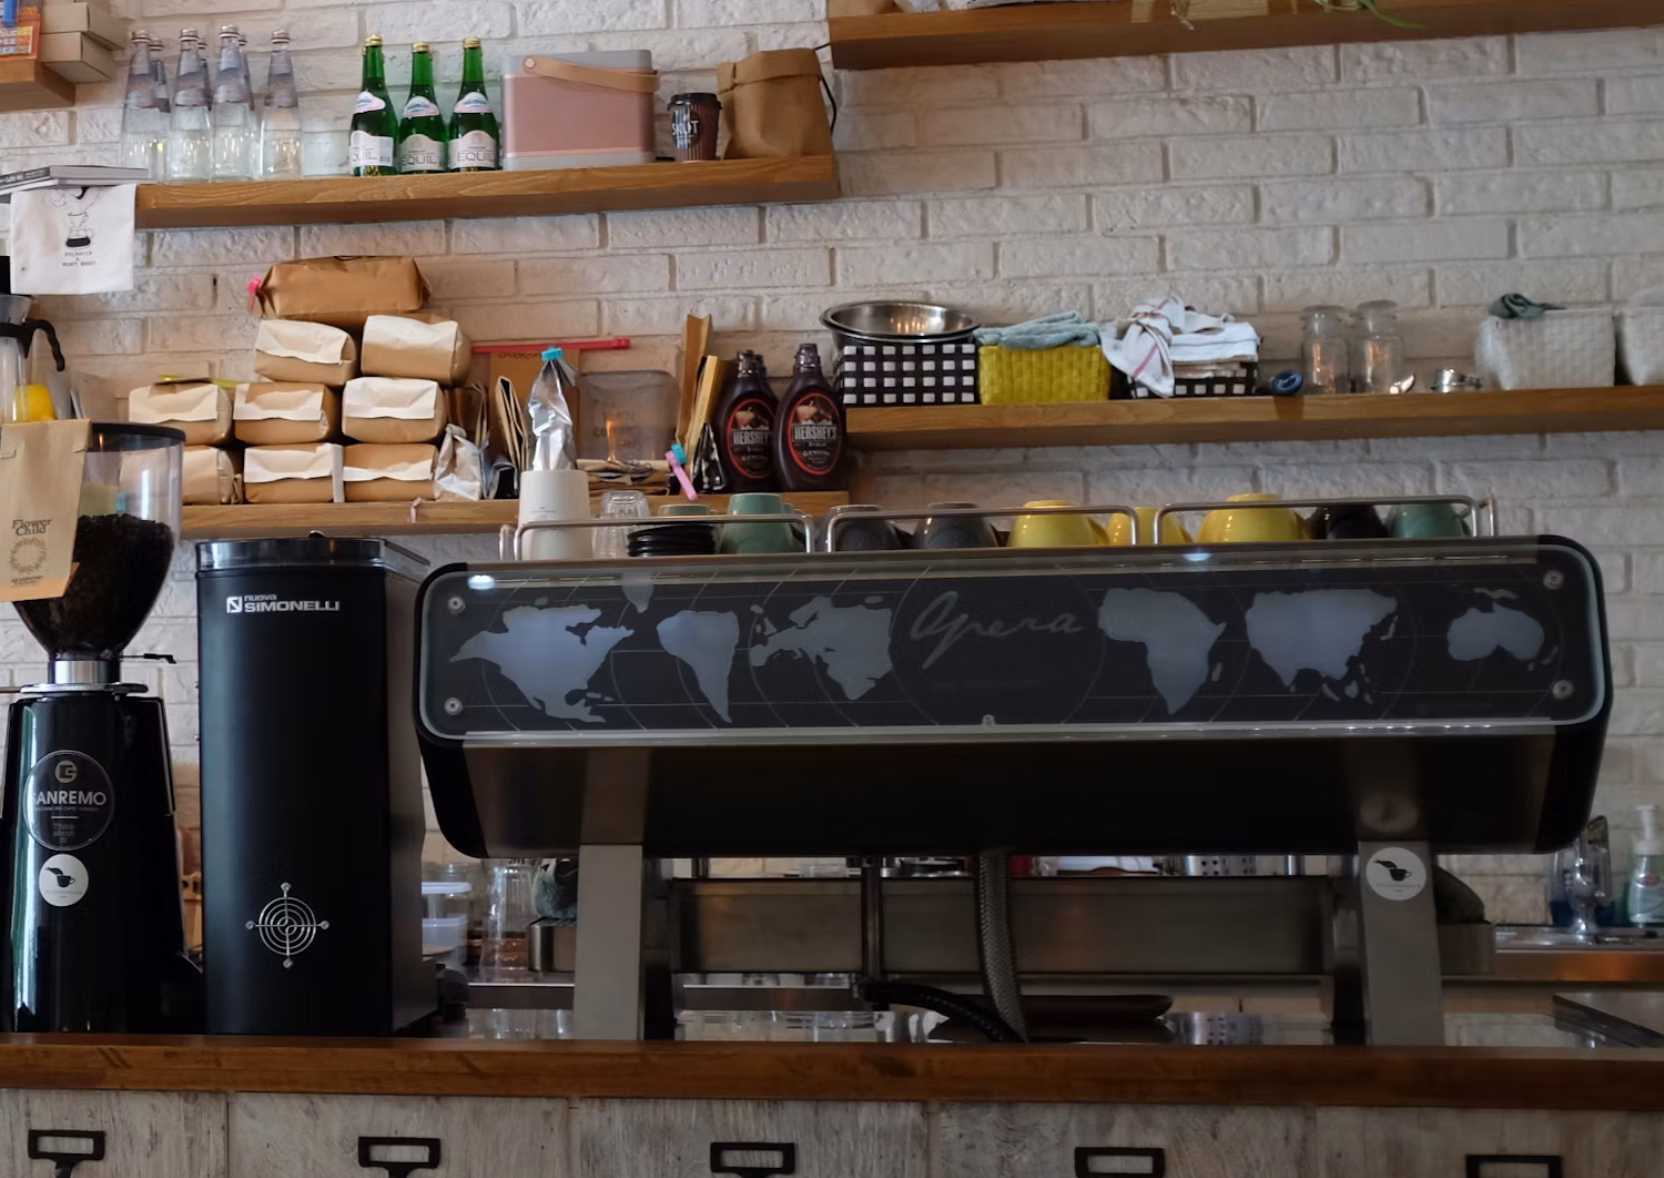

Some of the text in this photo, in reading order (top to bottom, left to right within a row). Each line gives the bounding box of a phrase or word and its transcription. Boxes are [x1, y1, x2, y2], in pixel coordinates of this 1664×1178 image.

[12, 519, 53, 529] Flower
[16, 525, 46, 536] Child
[244, 593, 277, 602] nuova
[244, 601, 340, 612] SIMONELLI
[910, 590, 1084, 669] Opera
